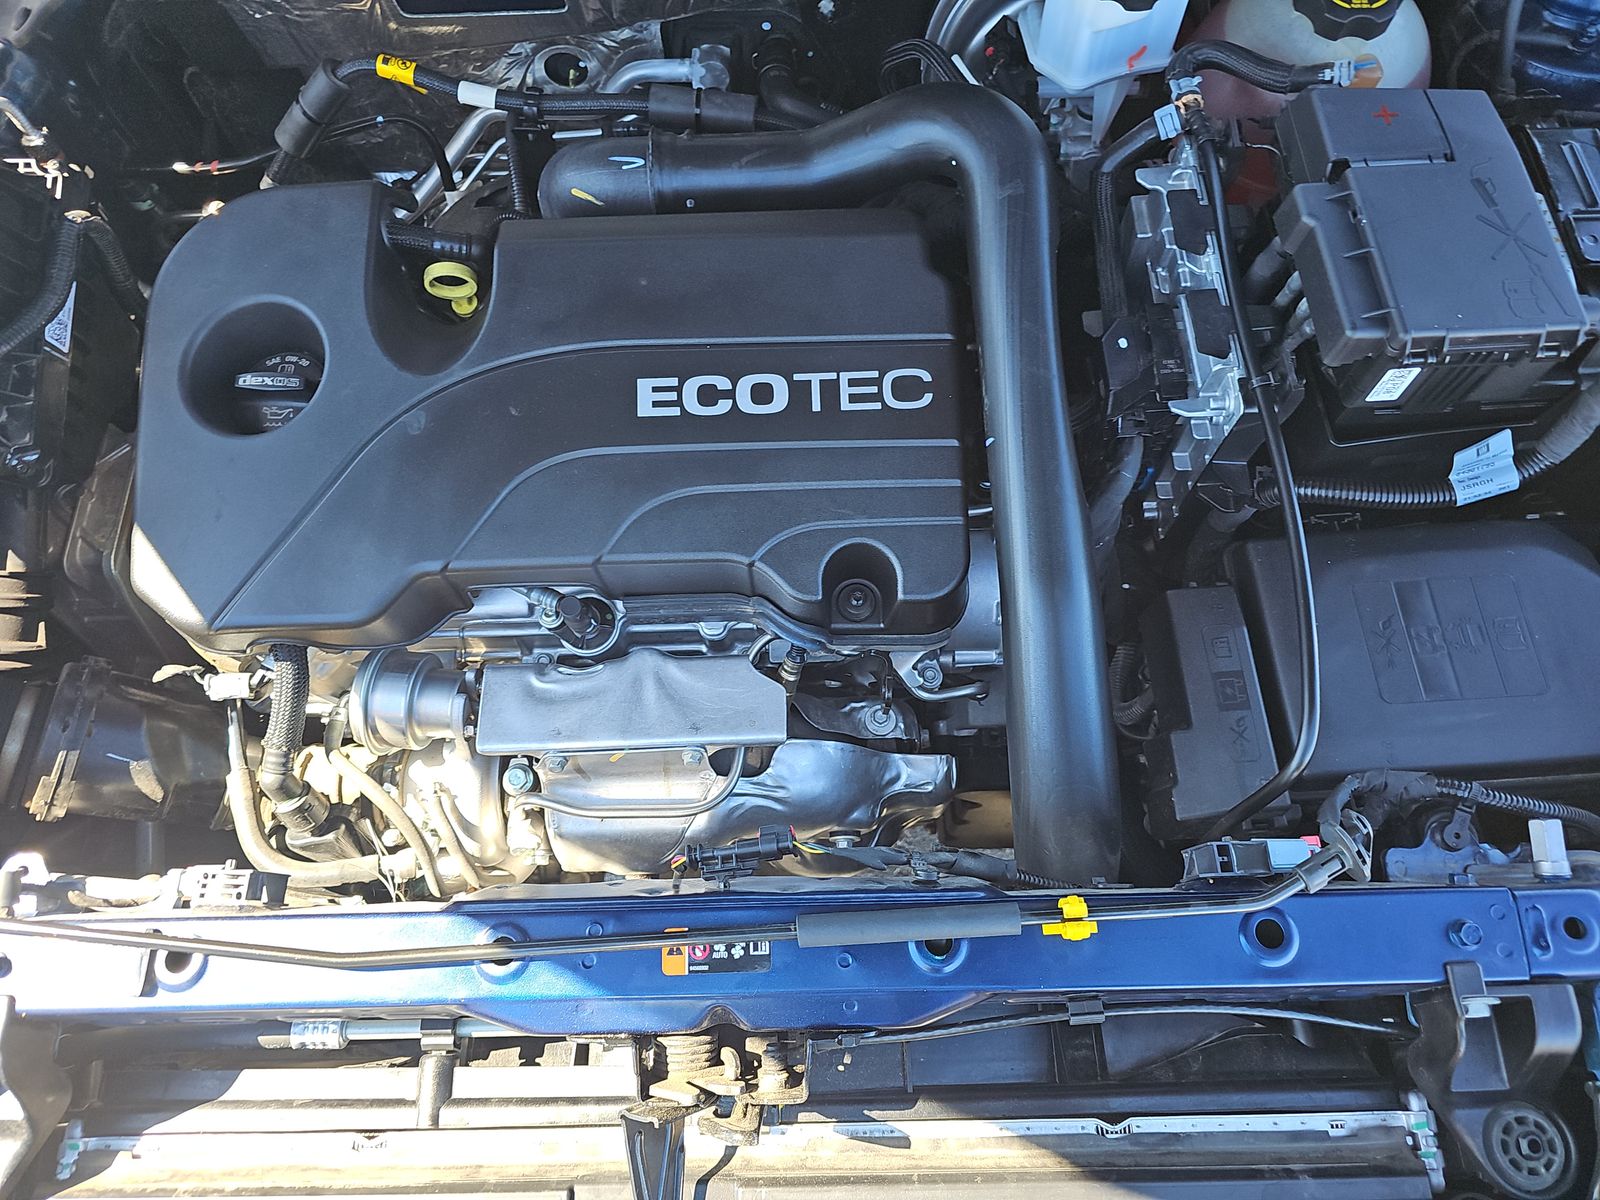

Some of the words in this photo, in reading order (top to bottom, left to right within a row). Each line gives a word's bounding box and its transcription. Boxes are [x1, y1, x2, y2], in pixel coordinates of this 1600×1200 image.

[265, 356, 281, 366] SAE
[285, 355, 310, 366] 0W-20
[238, 374, 300, 387] dexos
[636, 368, 934, 417] ECOTEC
[712, 951, 728, 959] AUTO
